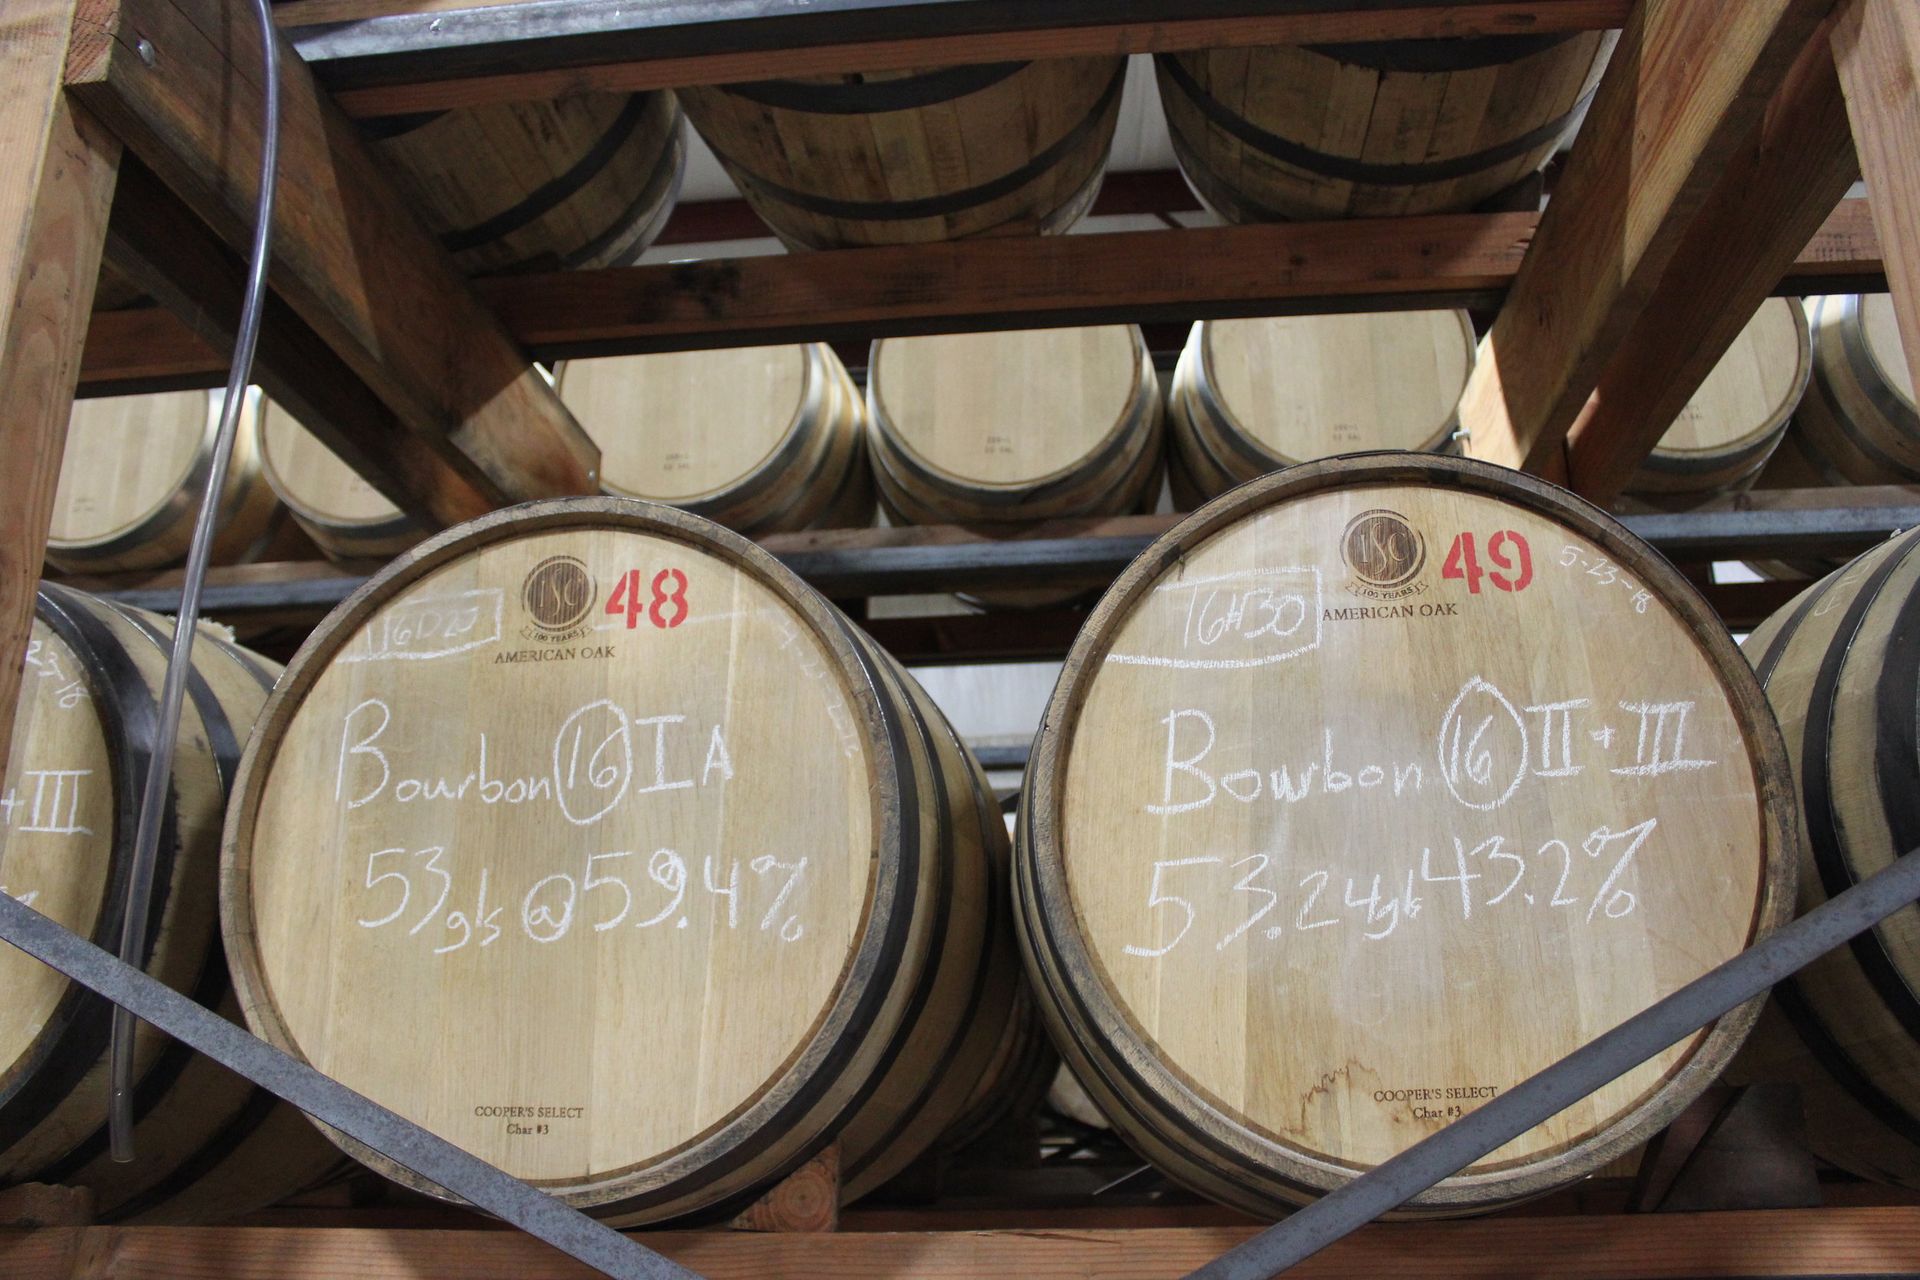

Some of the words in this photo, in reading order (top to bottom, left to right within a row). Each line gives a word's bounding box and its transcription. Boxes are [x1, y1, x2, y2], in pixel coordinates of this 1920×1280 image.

[1359, 521, 1407, 576] ISC
[1442, 529, 1534, 594] 49
[605, 568, 689, 629] 48
[1362, 588, 1378, 599] 100
[1382, 586, 1414, 600] YEARS
[1322, 605, 1414, 621] AMERICAN
[1419, 603, 1459, 617] OAK
[550, 630, 580, 642] YEARS
[494, 647, 576, 664] AMERICAN
[580, 645, 616, 660] OAK
[336, 699, 551, 810] Bourbon
[1146, 708, 1424, 815] Bourbon
[1373, 1088, 1442, 1102] COOPER'S
[1446, 1086, 1499, 1099] SELECT
[474, 1106, 534, 1118] COOPER'S
[537, 1106, 584, 1118] SELECT
[1412, 1106, 1443, 1120] Char
[1446, 1104, 1461, 1118] #3
[506, 1123, 533, 1135] Char
[536, 1124, 549, 1135] #3
